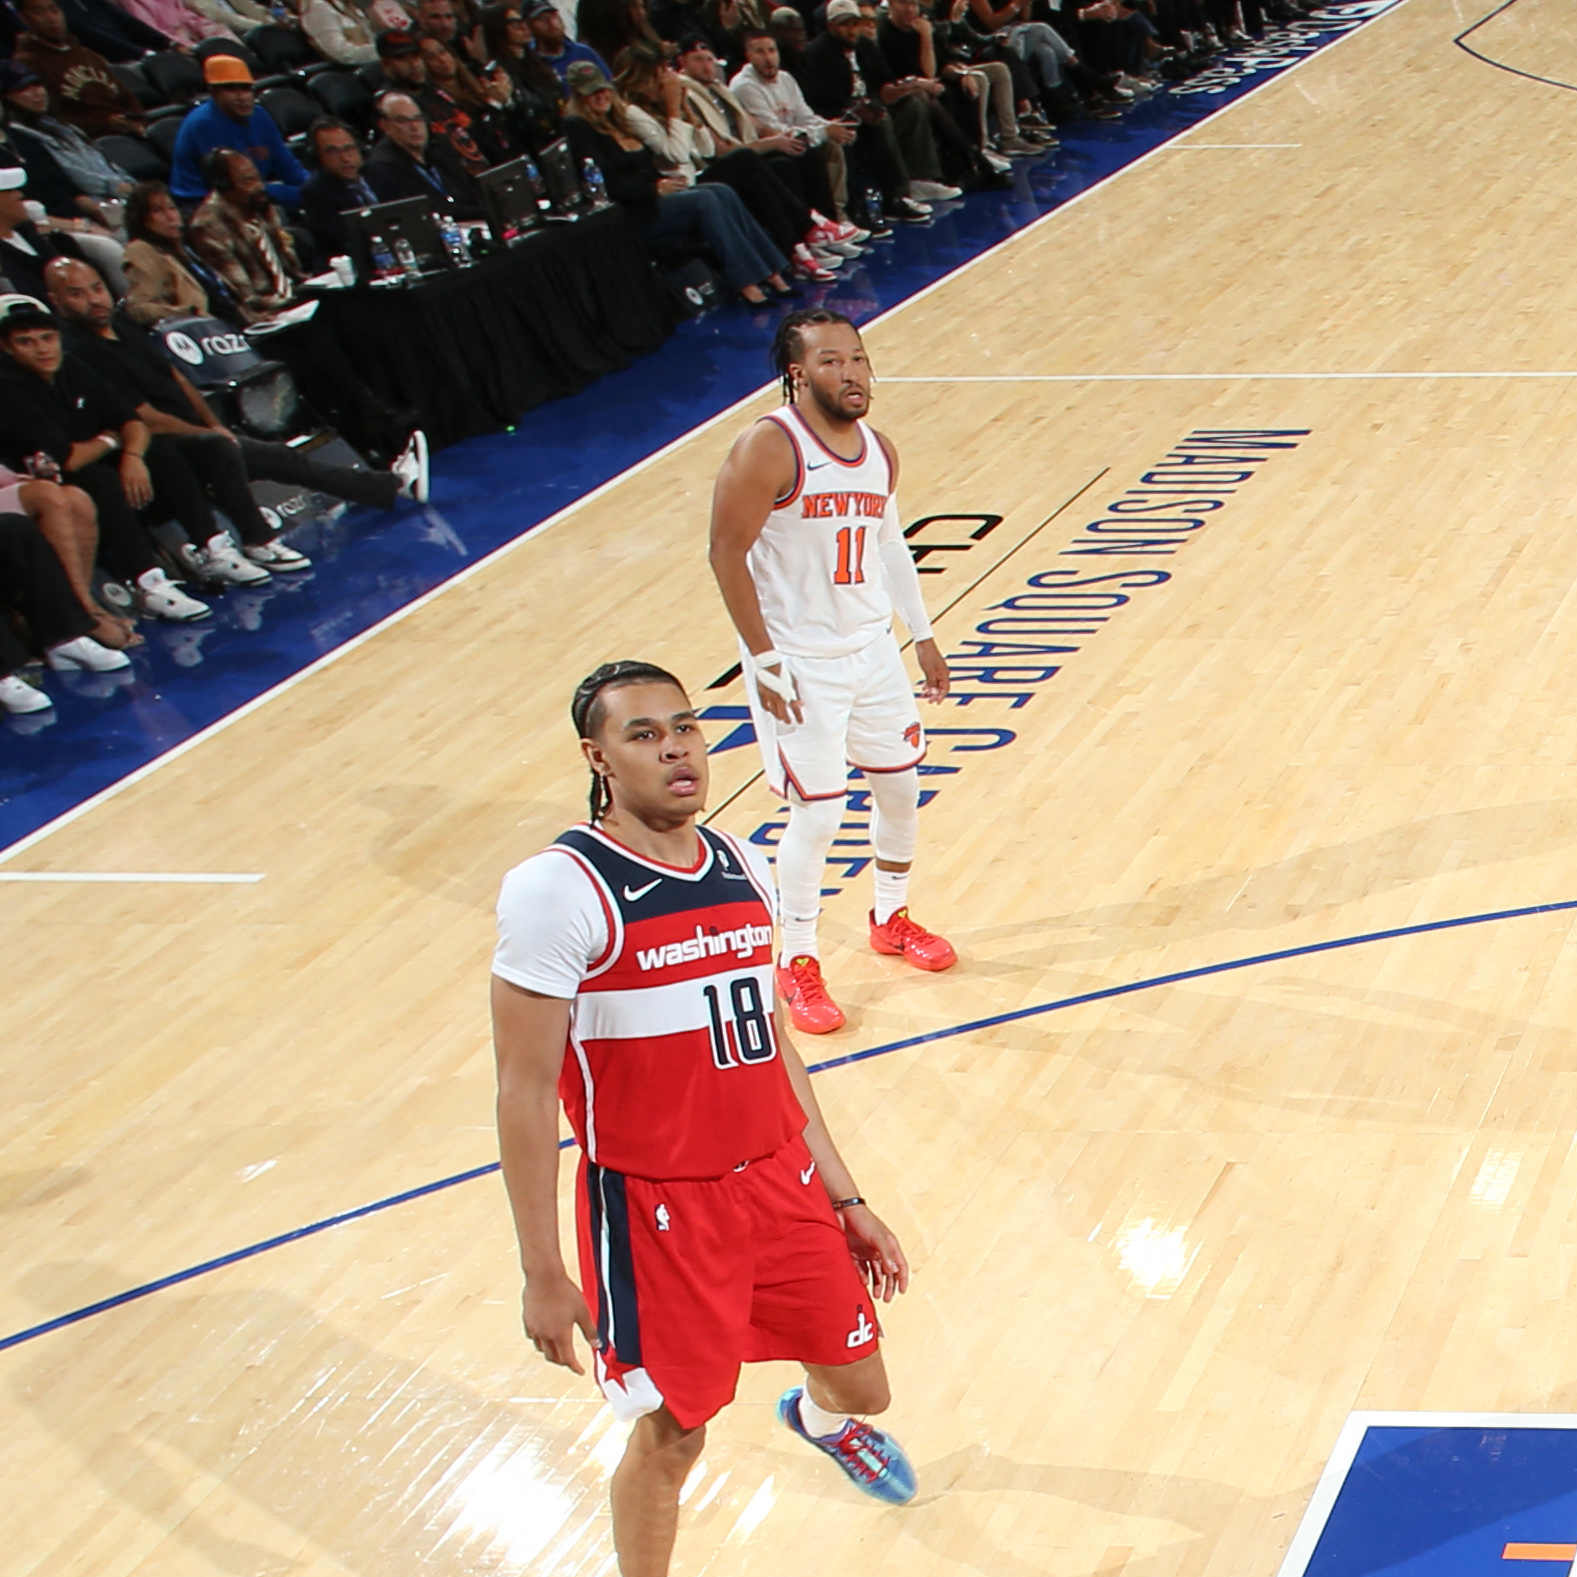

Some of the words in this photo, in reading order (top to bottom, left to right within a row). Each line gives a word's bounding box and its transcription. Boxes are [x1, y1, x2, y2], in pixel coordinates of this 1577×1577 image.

[802, 492, 850, 519] NEW
[1059, 429, 1311, 556] MADISON
[834, 525, 867, 585] 11
[914, 569, 1173, 709] SQUARE
[636, 923, 773, 972] washington
[703, 976, 776, 1069] 18
